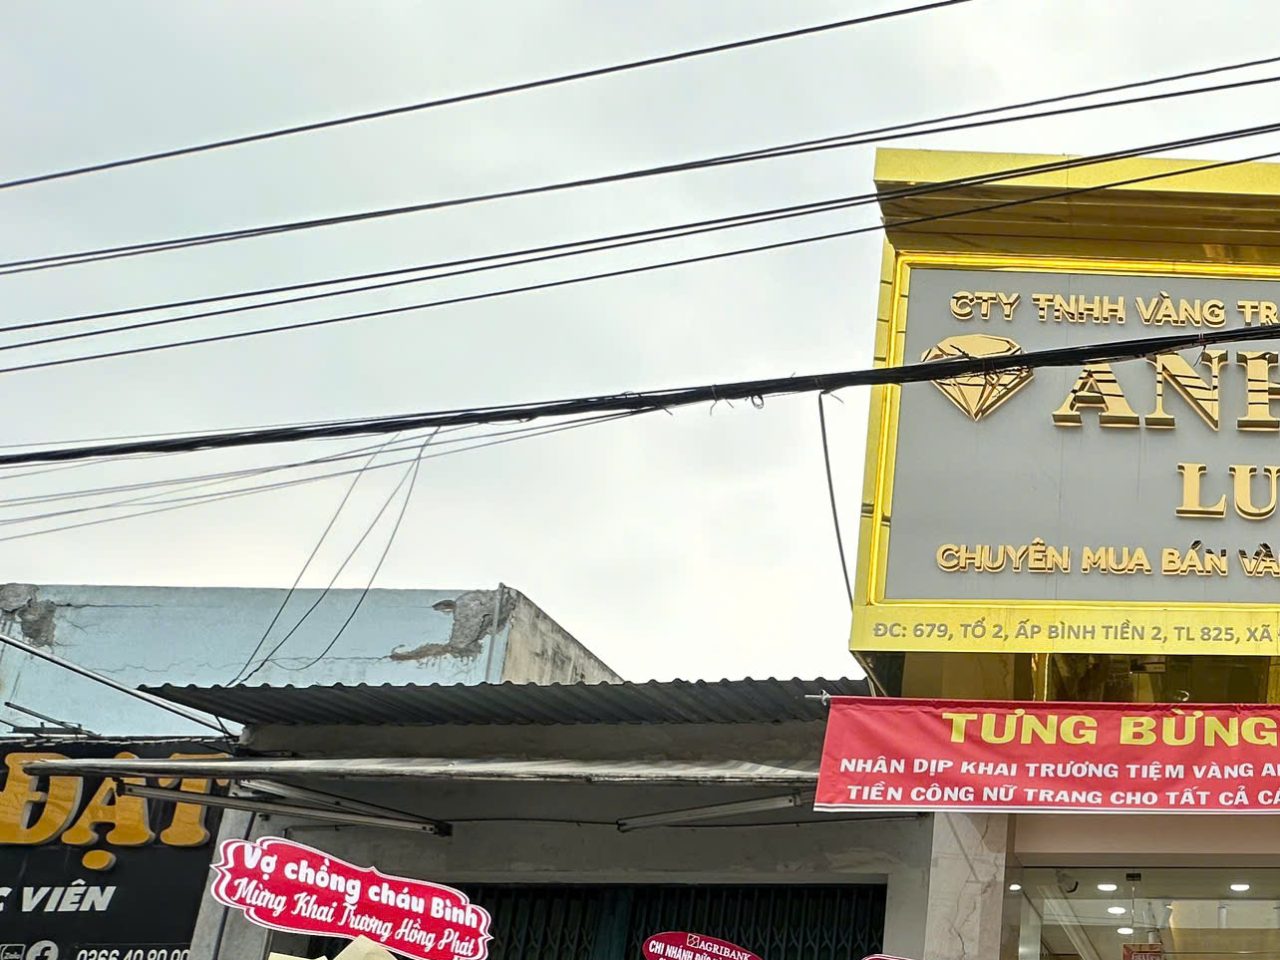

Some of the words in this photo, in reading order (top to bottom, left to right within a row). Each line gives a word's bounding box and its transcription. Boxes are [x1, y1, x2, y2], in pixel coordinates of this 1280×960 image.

[949, 291, 1021, 321] CTY
[1032, 293, 1125, 325] TNHH
[1135, 291, 1227, 328] VÀNG
[936, 537, 1071, 573] CHUYÊN
[1081, 546, 1152, 575] MUA
[1161, 540, 1229, 576] BÁN
[872, 622, 908, 639] ĐC:
[913, 622, 953, 642] 679,
[960, 616, 987, 640] TỔ
[992, 624, 1008, 643] 2,
[1015, 618, 1042, 640] ẤP
[1048, 620, 1096, 642] BÌNH
[1101, 617, 1146, 642] TIỀN
[1150, 626, 1167, 645] 2,
[1173, 626, 1197, 641] TL
[1200, 626, 1240, 645] 825,
[1246, 620, 1273, 643] XÃ
[942, 708, 1097, 746] TƯNG
[1119, 708, 1278, 747] BỪNG
[840, 755, 906, 775] NHÂN
[913, 758, 954, 776] DỊP
[960, 761, 1017, 777] KHAI
[1025, 760, 1119, 780] TRƯƠNG
[1126, 760, 1185, 781] TIỆM
[1192, 759, 1254, 780] VÀNG
[846, 780, 902, 801] TIỀN
[909, 781, 974, 802] CÔNG
[981, 783, 1016, 802] NỮ
[1024, 787, 1103, 805] TRANG
[1109, 789, 1159, 806] CHO
[1164, 783, 1210, 806] TẤT
[1218, 781, 1249, 806] CẢ
[22, 879, 117, 912] VIÊN
[243, 843, 278, 881] Vợ
[284, 856, 362, 905] chồng
[368, 882, 424, 914] cháu
[431, 895, 479, 929] Bình
[232, 877, 288, 918] Mừng
[291, 891, 336, 925] Khai
[337, 902, 394, 940] Trương
[395, 917, 437, 952] Hồng
[438, 927, 475, 958] Phát
[649, 939, 664, 955] CHI
